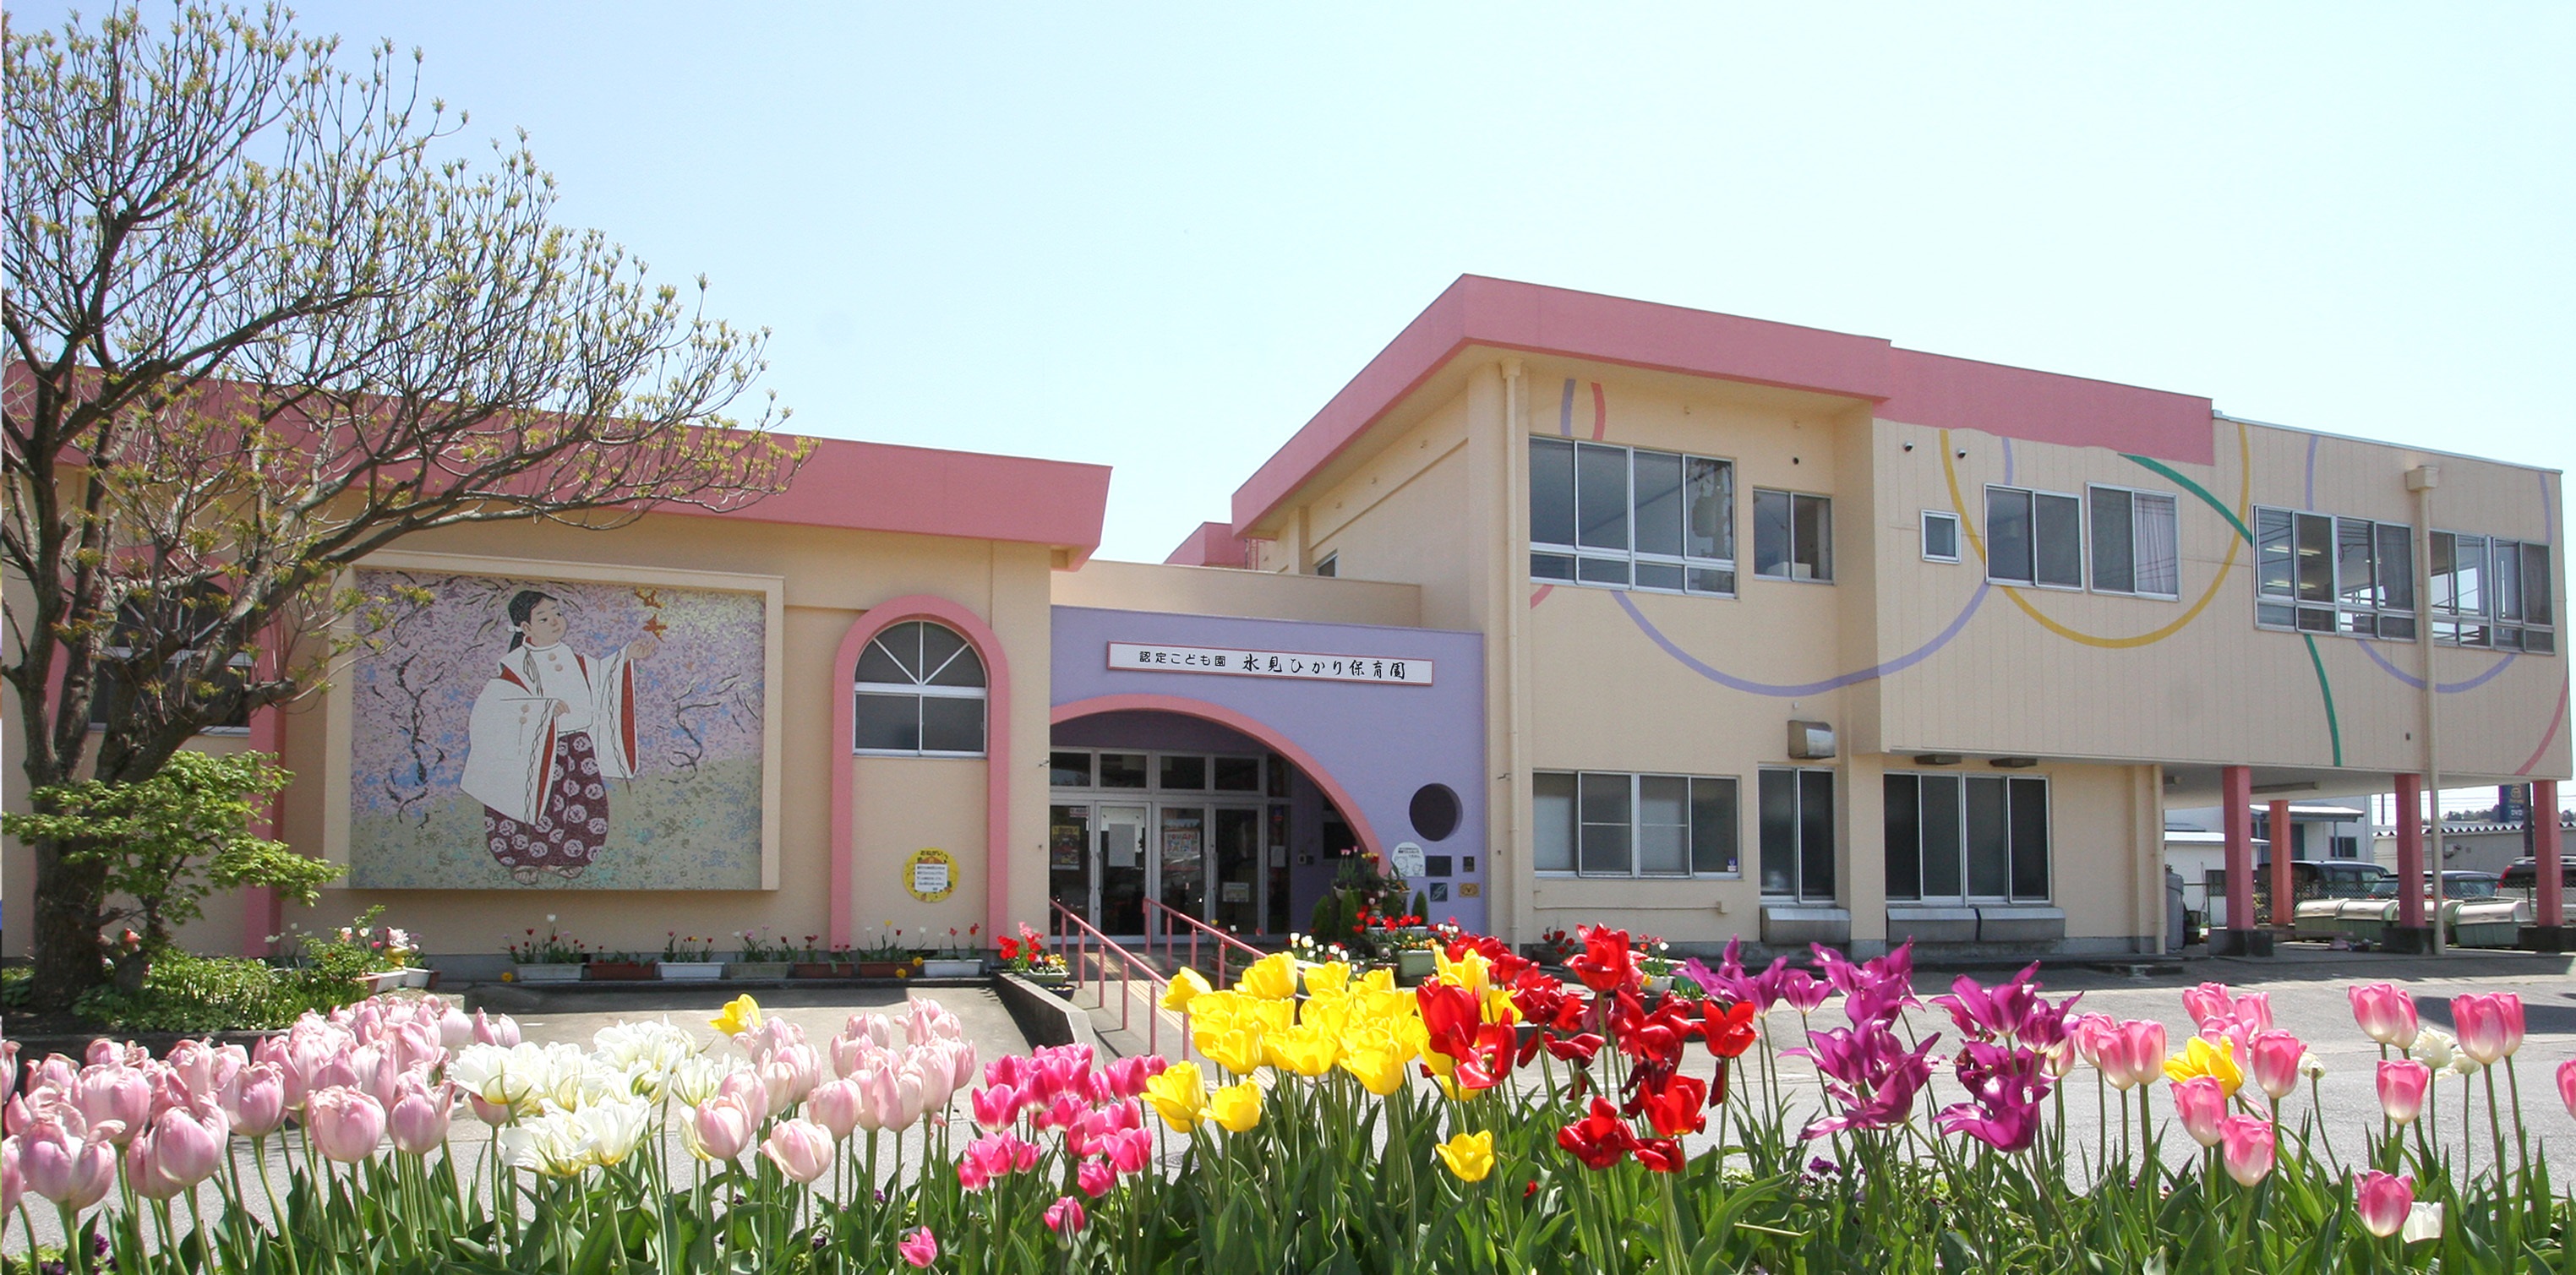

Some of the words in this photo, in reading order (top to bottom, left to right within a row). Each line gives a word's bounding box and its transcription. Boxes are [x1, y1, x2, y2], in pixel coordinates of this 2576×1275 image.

[1139, 651, 1225, 667] 認定こども園
[1242, 653, 1405, 679] 氷見ひかり保育園
